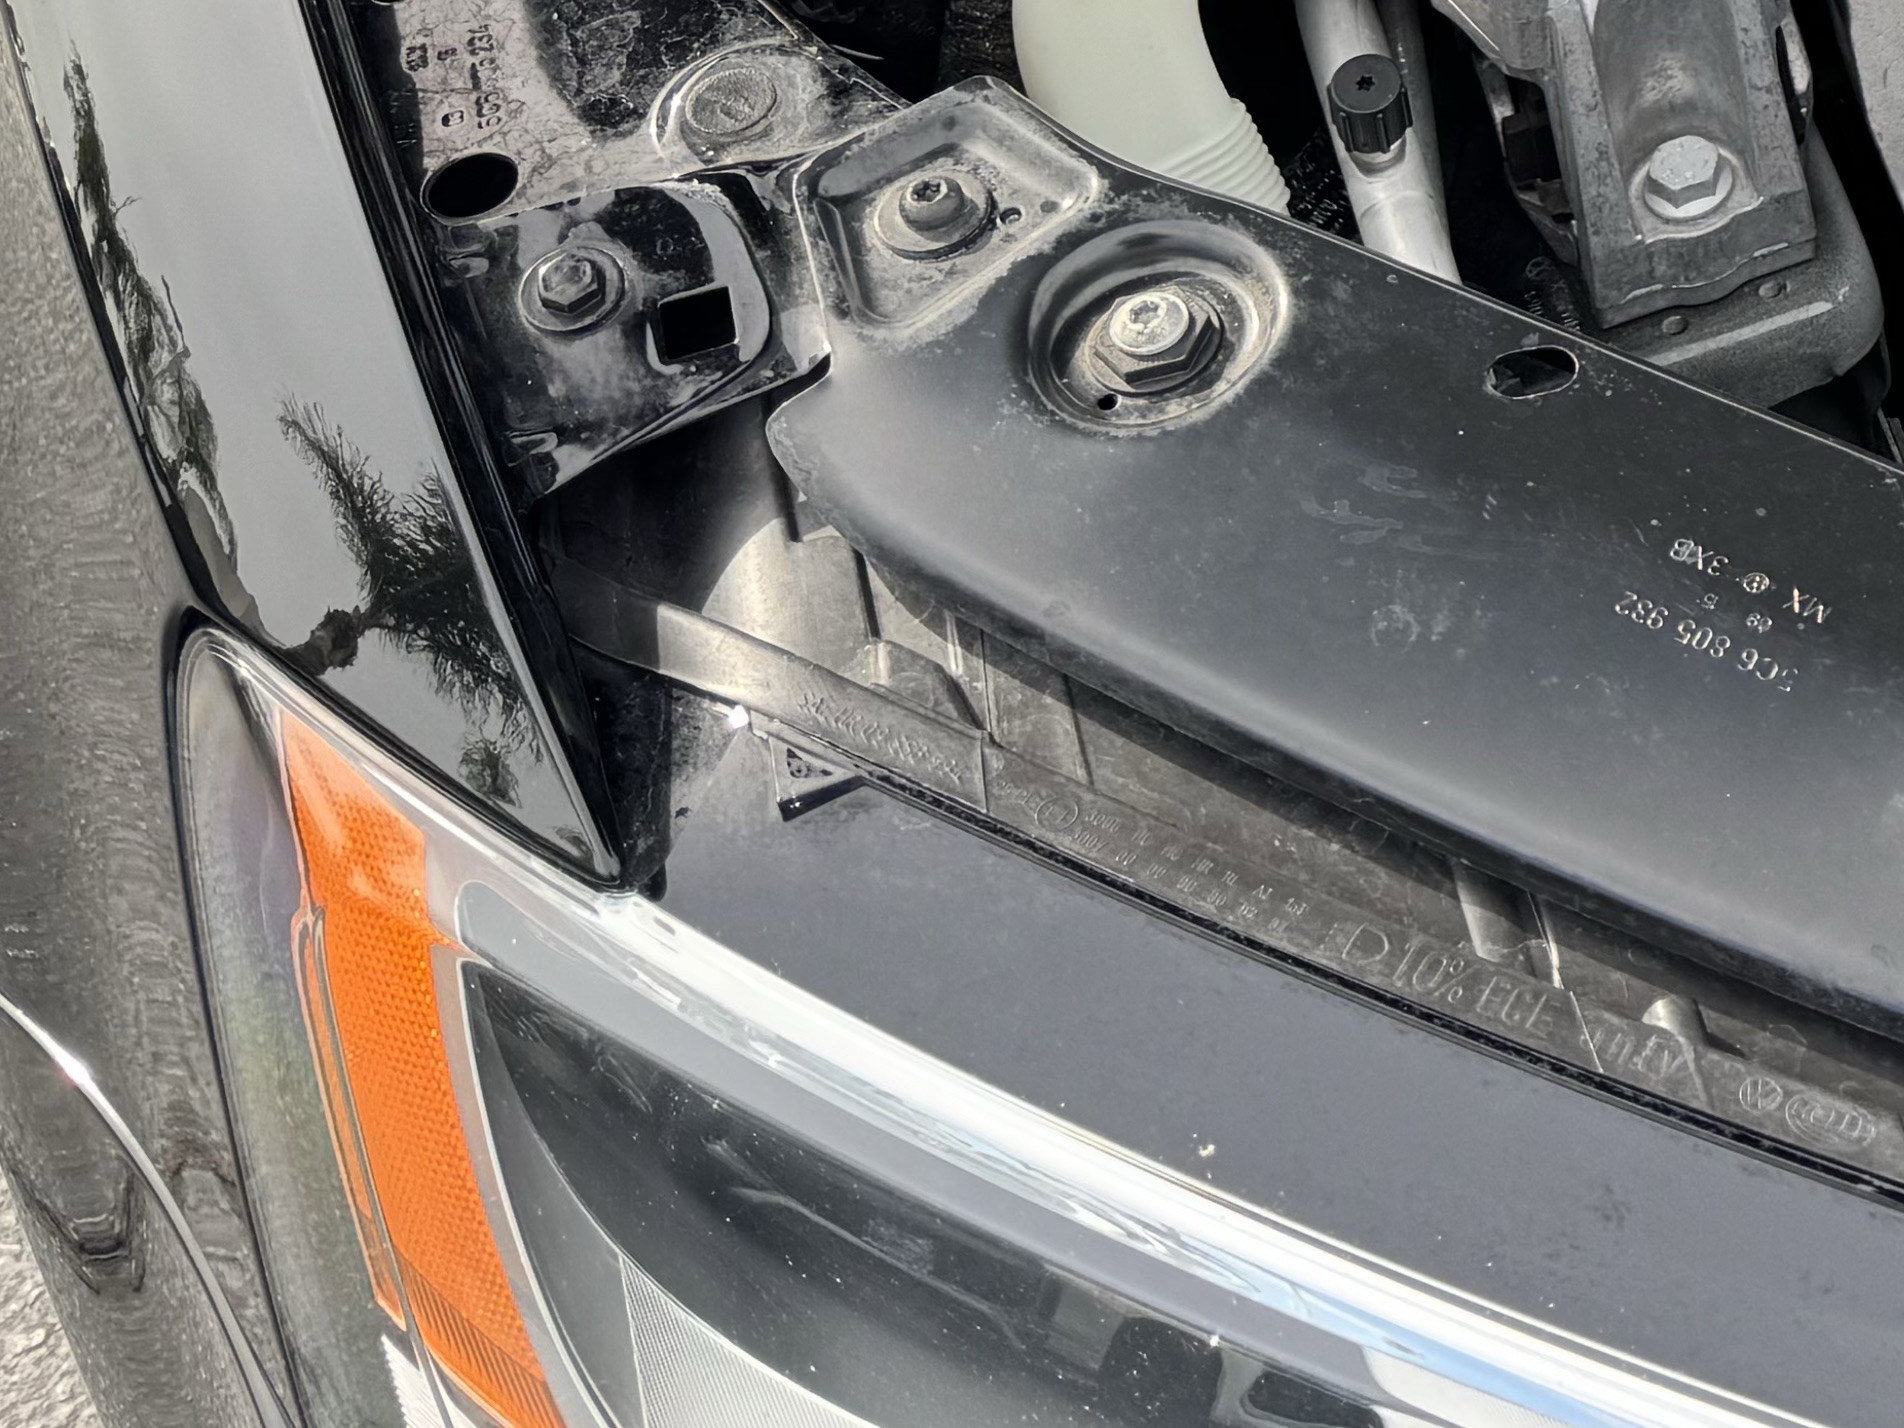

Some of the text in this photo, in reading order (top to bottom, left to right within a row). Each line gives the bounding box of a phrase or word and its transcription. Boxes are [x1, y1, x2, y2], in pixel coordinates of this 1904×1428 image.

[1614, 591, 1669, 630] 932
[1782, 585, 1832, 625] MX
[1673, 618, 1732, 658] 805
